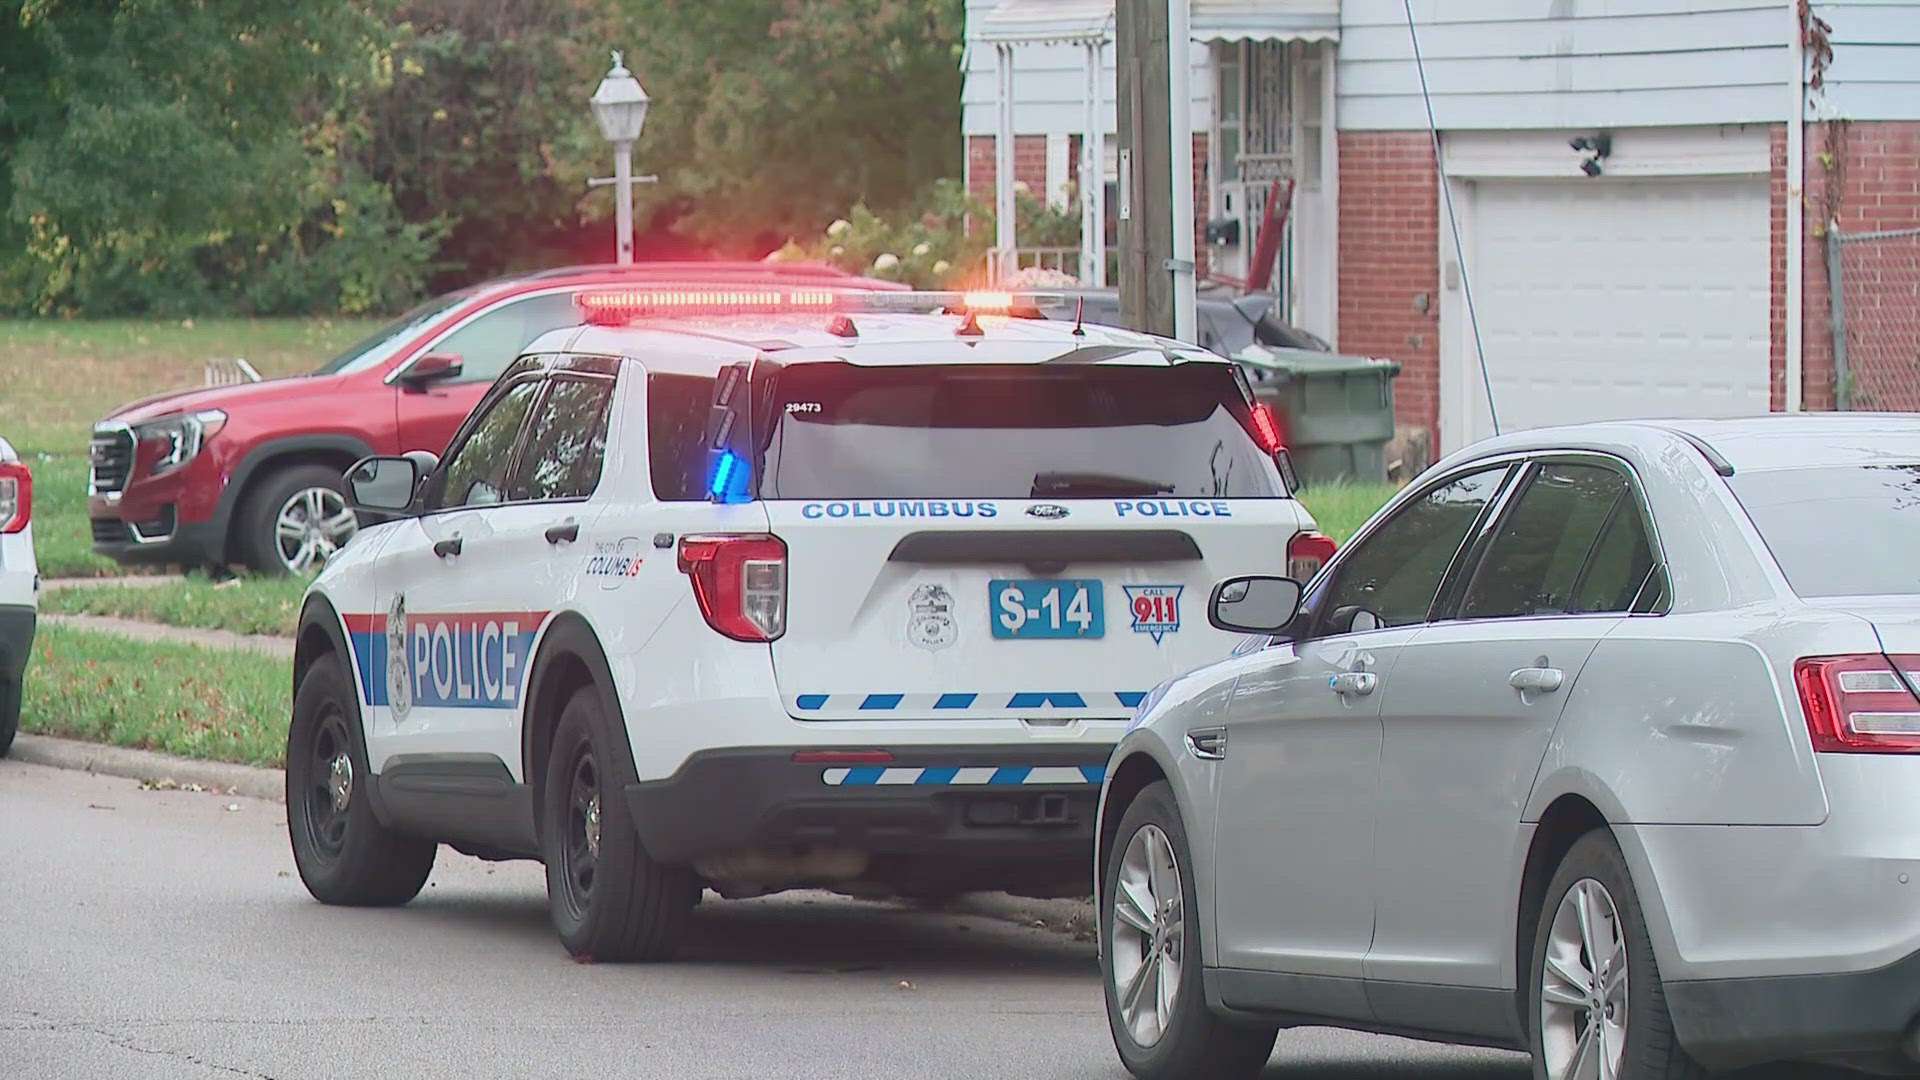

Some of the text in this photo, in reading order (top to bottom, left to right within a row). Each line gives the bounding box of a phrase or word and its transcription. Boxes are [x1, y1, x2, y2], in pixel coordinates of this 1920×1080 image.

[801, 501, 998, 519] COLUMBUS
[1114, 501, 1232, 518] POLICE
[586, 556, 643, 577] COLUMBUS
[1143, 588, 1165, 596] CALL
[999, 587, 1093, 630] S-14
[414, 620, 519, 701] POLICE
